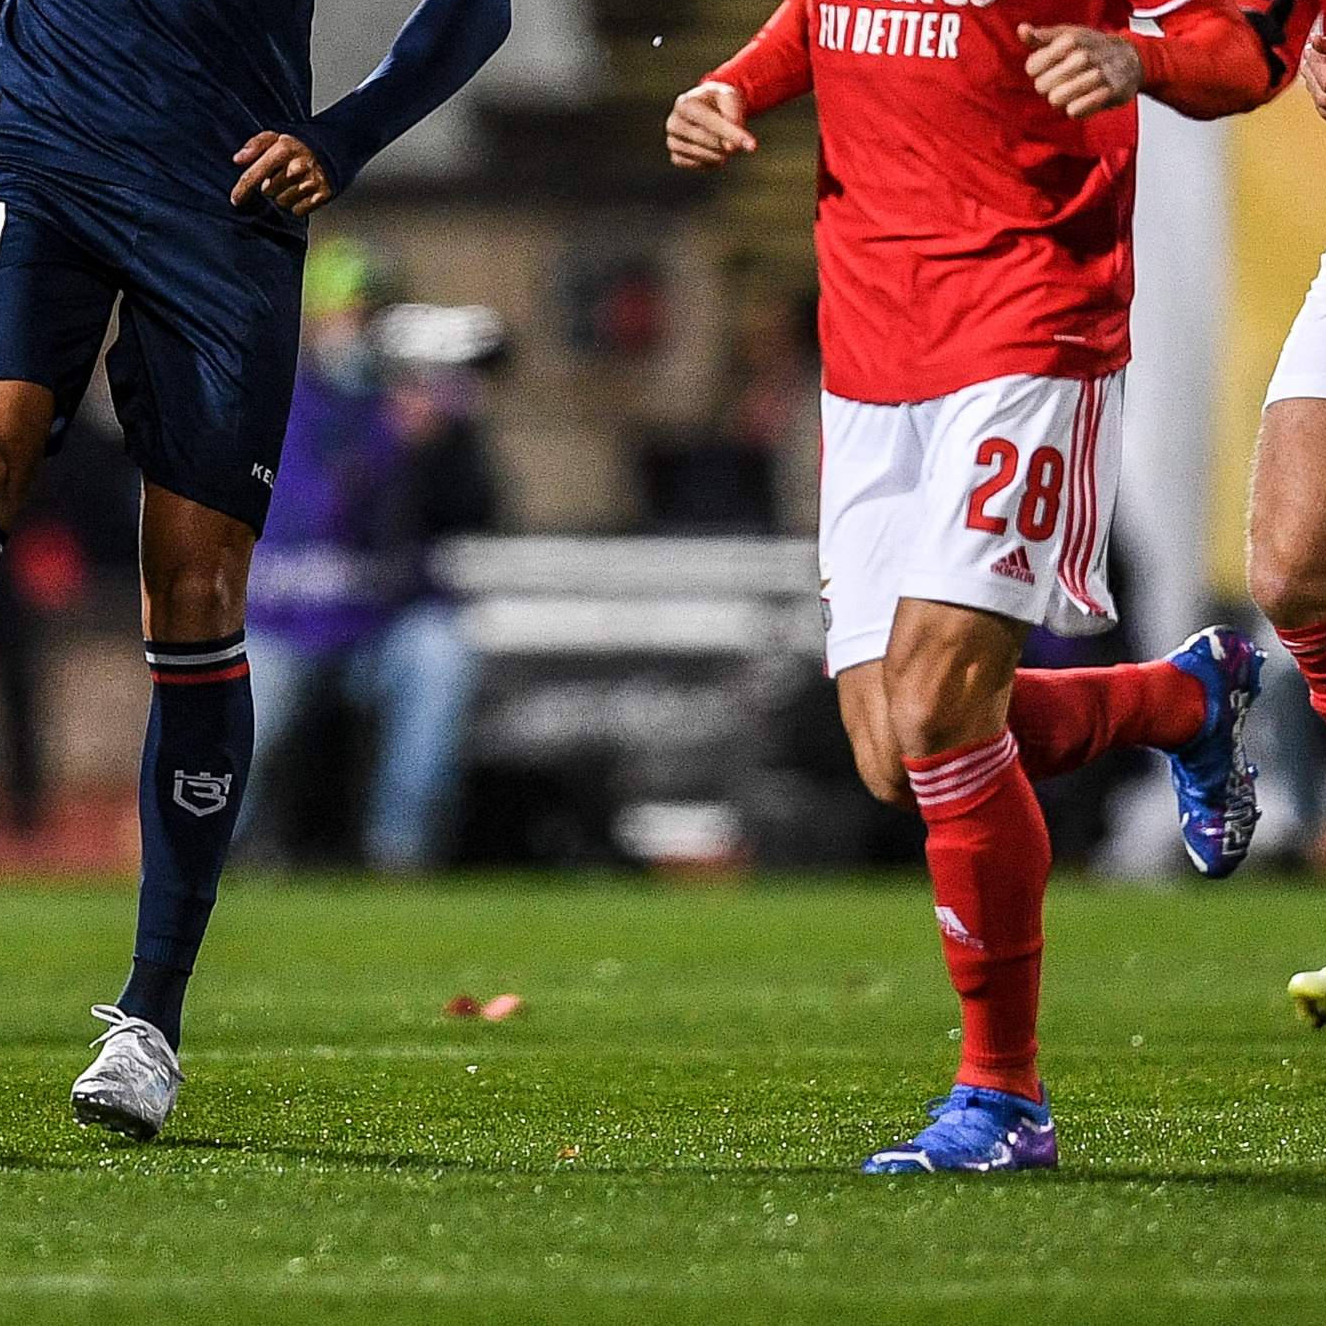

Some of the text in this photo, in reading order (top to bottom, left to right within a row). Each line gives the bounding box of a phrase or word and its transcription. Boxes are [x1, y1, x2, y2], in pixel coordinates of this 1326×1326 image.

[818, 3, 961, 59] FLY BETTER
[251, 462, 275, 489] KEL
[965, 436, 1064, 543] 28
